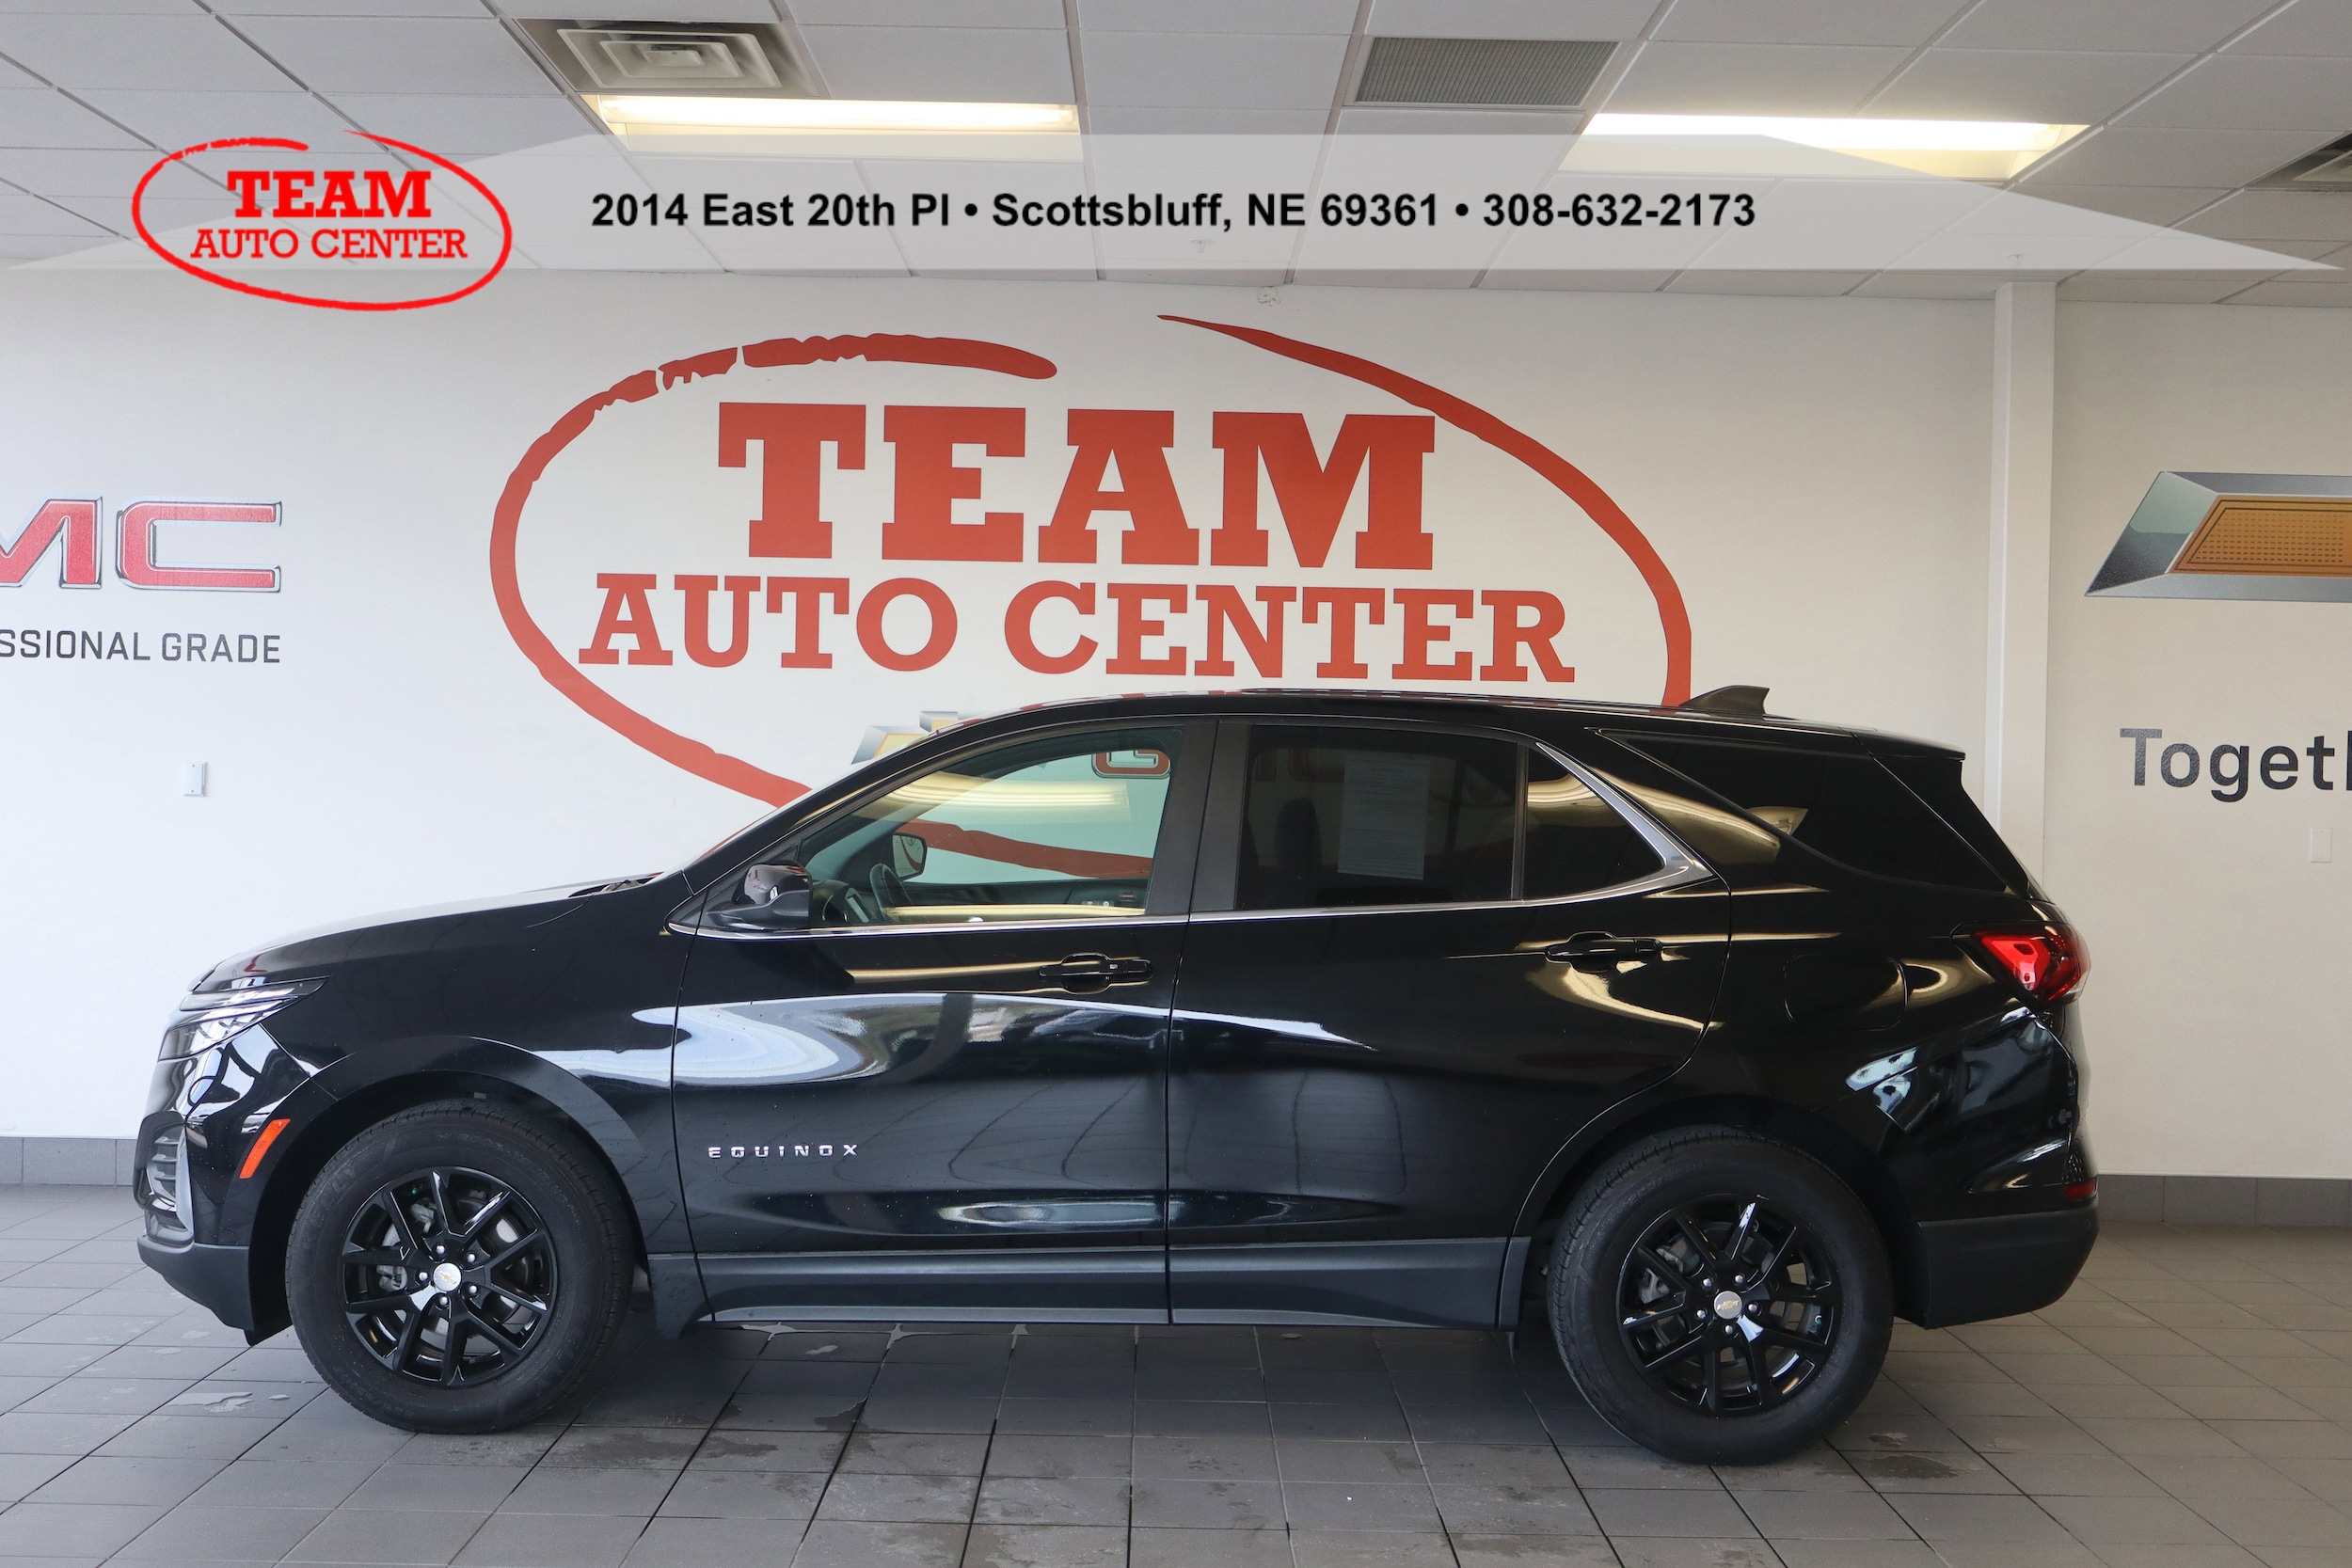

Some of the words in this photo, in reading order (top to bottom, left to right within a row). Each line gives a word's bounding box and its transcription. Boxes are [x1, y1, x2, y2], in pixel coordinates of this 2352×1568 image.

[718, 402, 1436, 570] TEAM
[0, 628, 151, 661] SSIONAL
[162, 633, 280, 663] GRADE
[579, 573, 958, 672] AUTO
[1004, 579, 1576, 683] CENTER
[2120, 728, 2352, 802] Toget
[708, 1144, 858, 1159] EQUINOX
